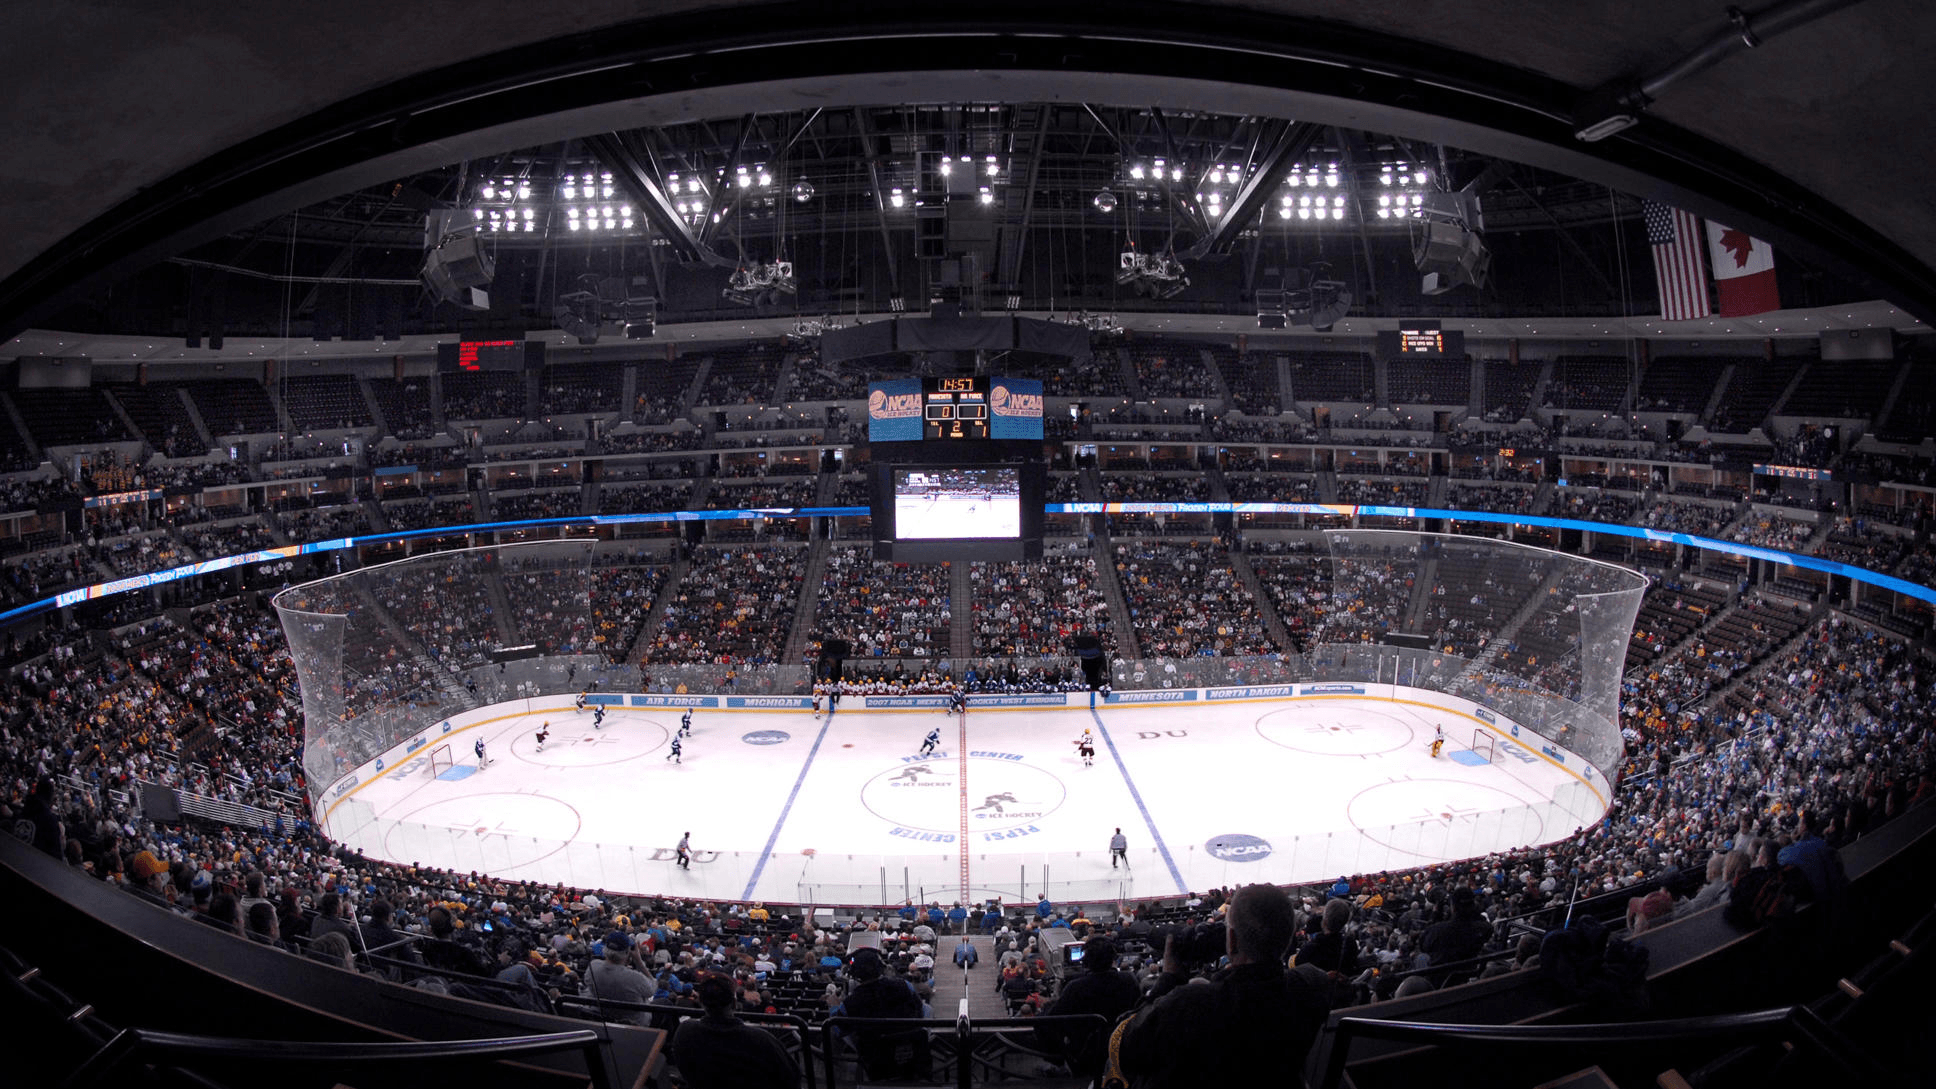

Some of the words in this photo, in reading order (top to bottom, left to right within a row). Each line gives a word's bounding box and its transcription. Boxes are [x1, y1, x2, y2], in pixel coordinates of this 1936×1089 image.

[944, 378, 973, 391] 14:57
[888, 394, 922, 411] NCAA
[1010, 394, 1043, 409] NCAA
[942, 406, 950, 418] 0
[977, 406, 982, 418] 1
[938, 425, 943, 438] 1
[953, 420, 961, 432] 2
[982, 425, 987, 438] 1
[1073, 503, 1102, 512] NCAA
[1276, 504, 1311, 513] DENVER
[1118, 691, 1184, 701] MINNESOTA
[1210, 689, 1247, 698] NORTH
[1248, 686, 1289, 696] DAKOTA
[646, 697, 665, 705] AIR
[666, 696, 703, 706] FORCE
[745, 698, 802, 707] MICHIGAN
[1026, 696, 1066, 704] REGIONAL
[1137, 729, 1188, 740] DU
[970, 750, 1024, 761] CENTER
[889, 827, 956, 843] CENTER
[984, 824, 1041, 841] PEPSI
[1215, 844, 1272, 857] NCAA
